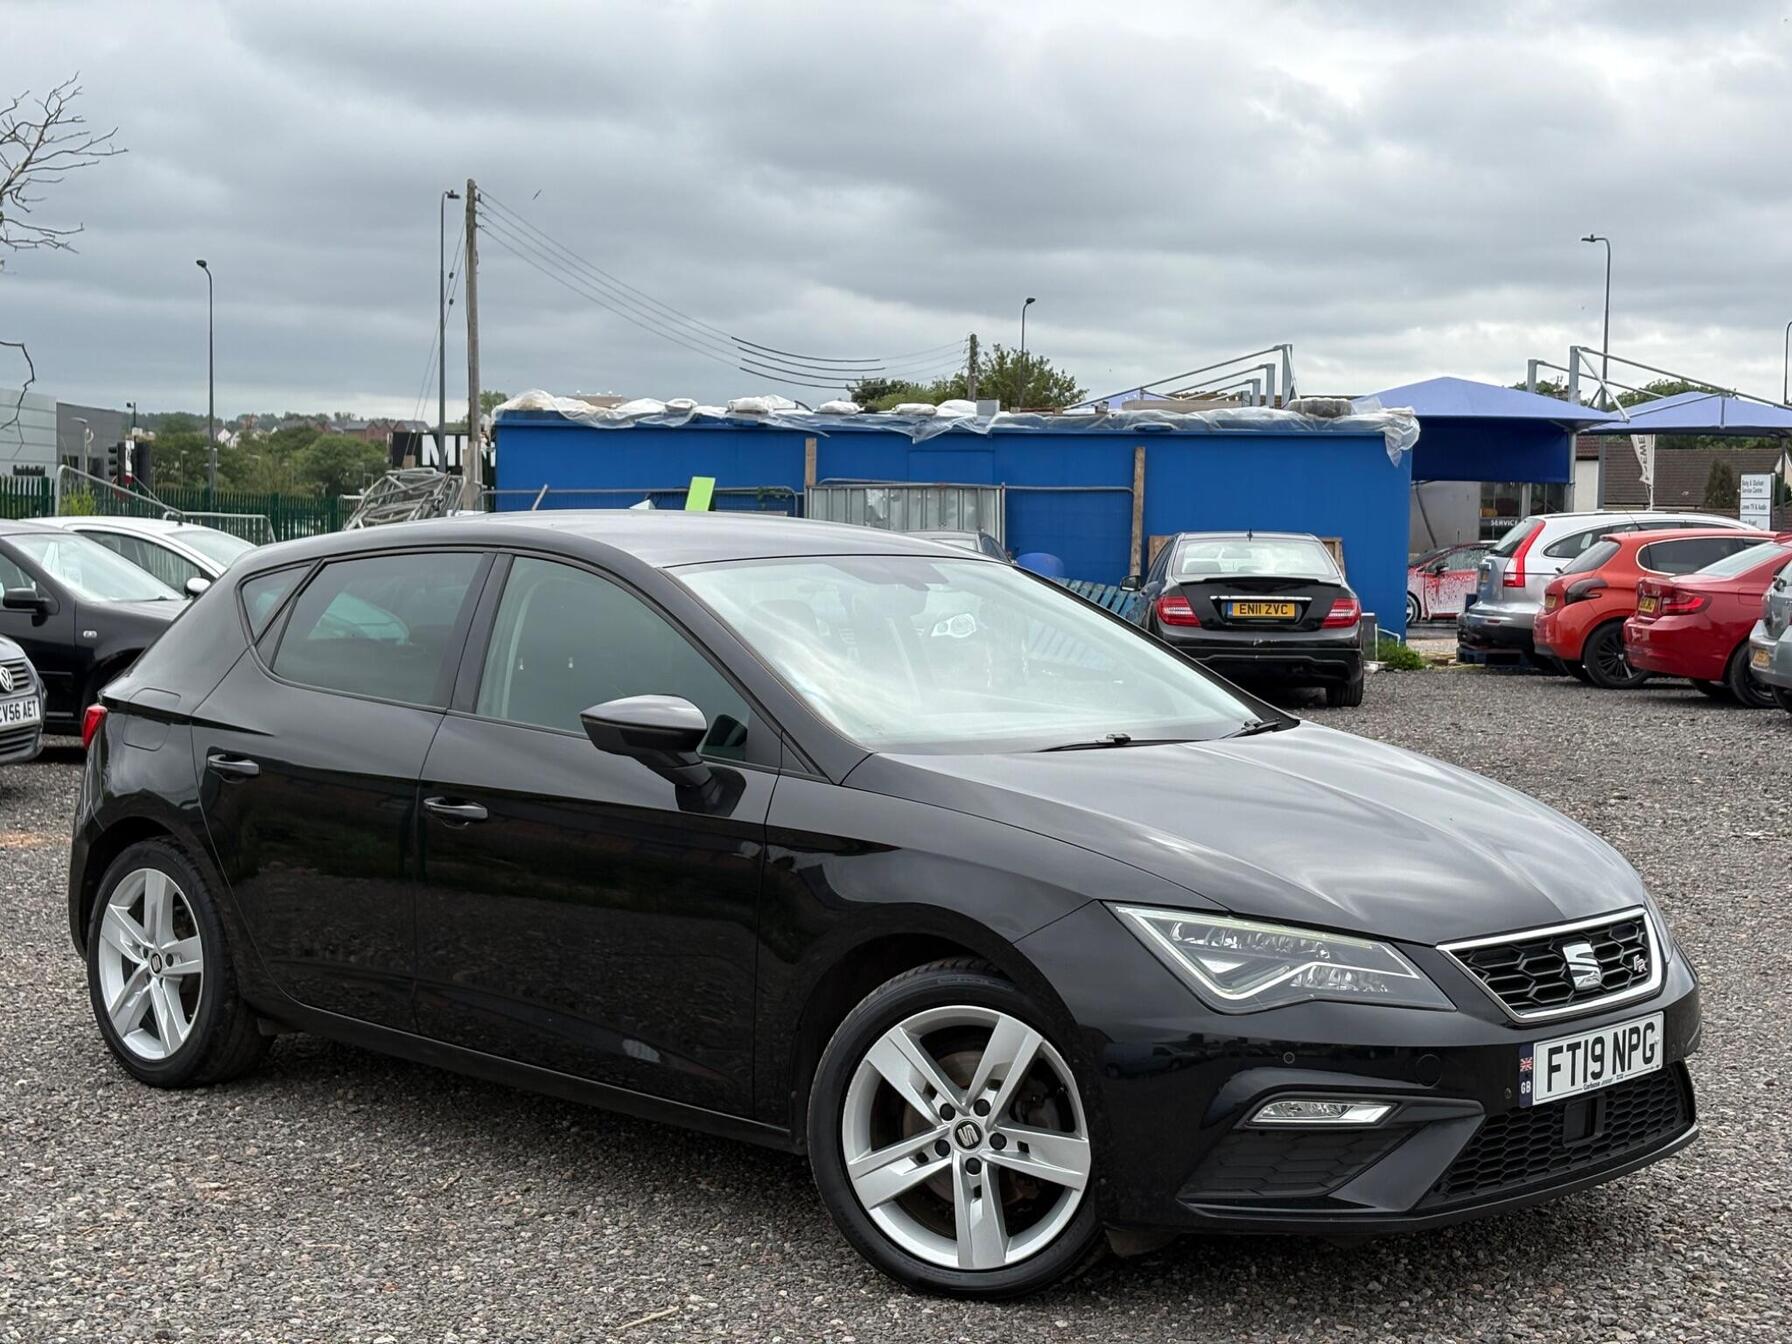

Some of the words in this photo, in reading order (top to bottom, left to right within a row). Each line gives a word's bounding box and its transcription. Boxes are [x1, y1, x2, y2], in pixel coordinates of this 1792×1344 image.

[1239, 603, 1262, 615] EN11
[1264, 603, 1289, 615] ZVC
[23, 701, 37, 719] AET
[1547, 1035, 1606, 1093] FT19
[1612, 1021, 1656, 1076] NPG
[1520, 1080, 1531, 1094] GB
